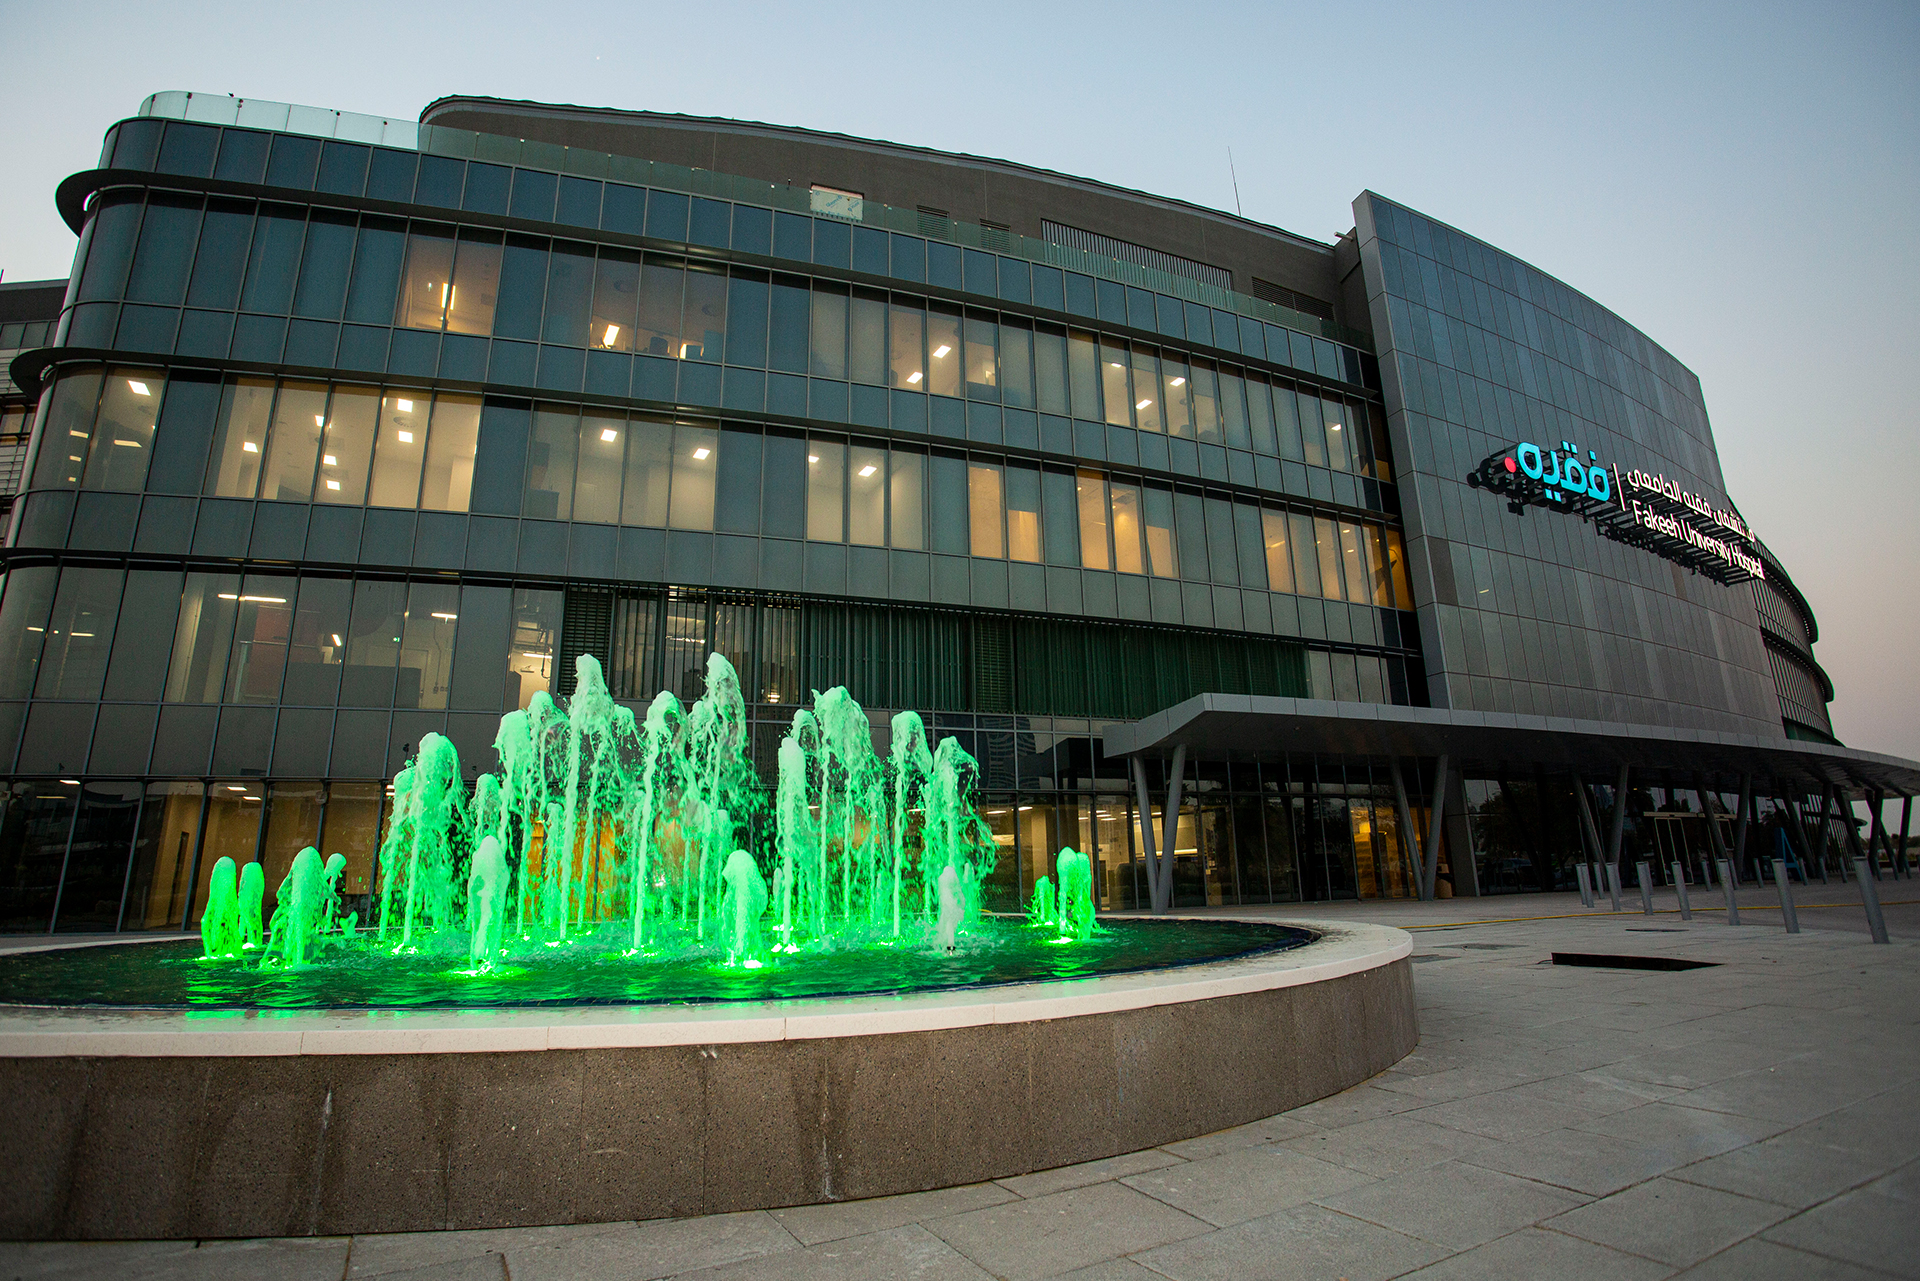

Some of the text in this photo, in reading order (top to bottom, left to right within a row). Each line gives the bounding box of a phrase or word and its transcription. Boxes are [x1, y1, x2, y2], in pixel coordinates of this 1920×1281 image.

[1517, 441, 1610, 502] فقيه
[1627, 469, 1683, 503] الجامعي
[1682, 491, 1712, 518] فقيه
[1632, 500, 1765, 580] Fakeeh University Hospital
